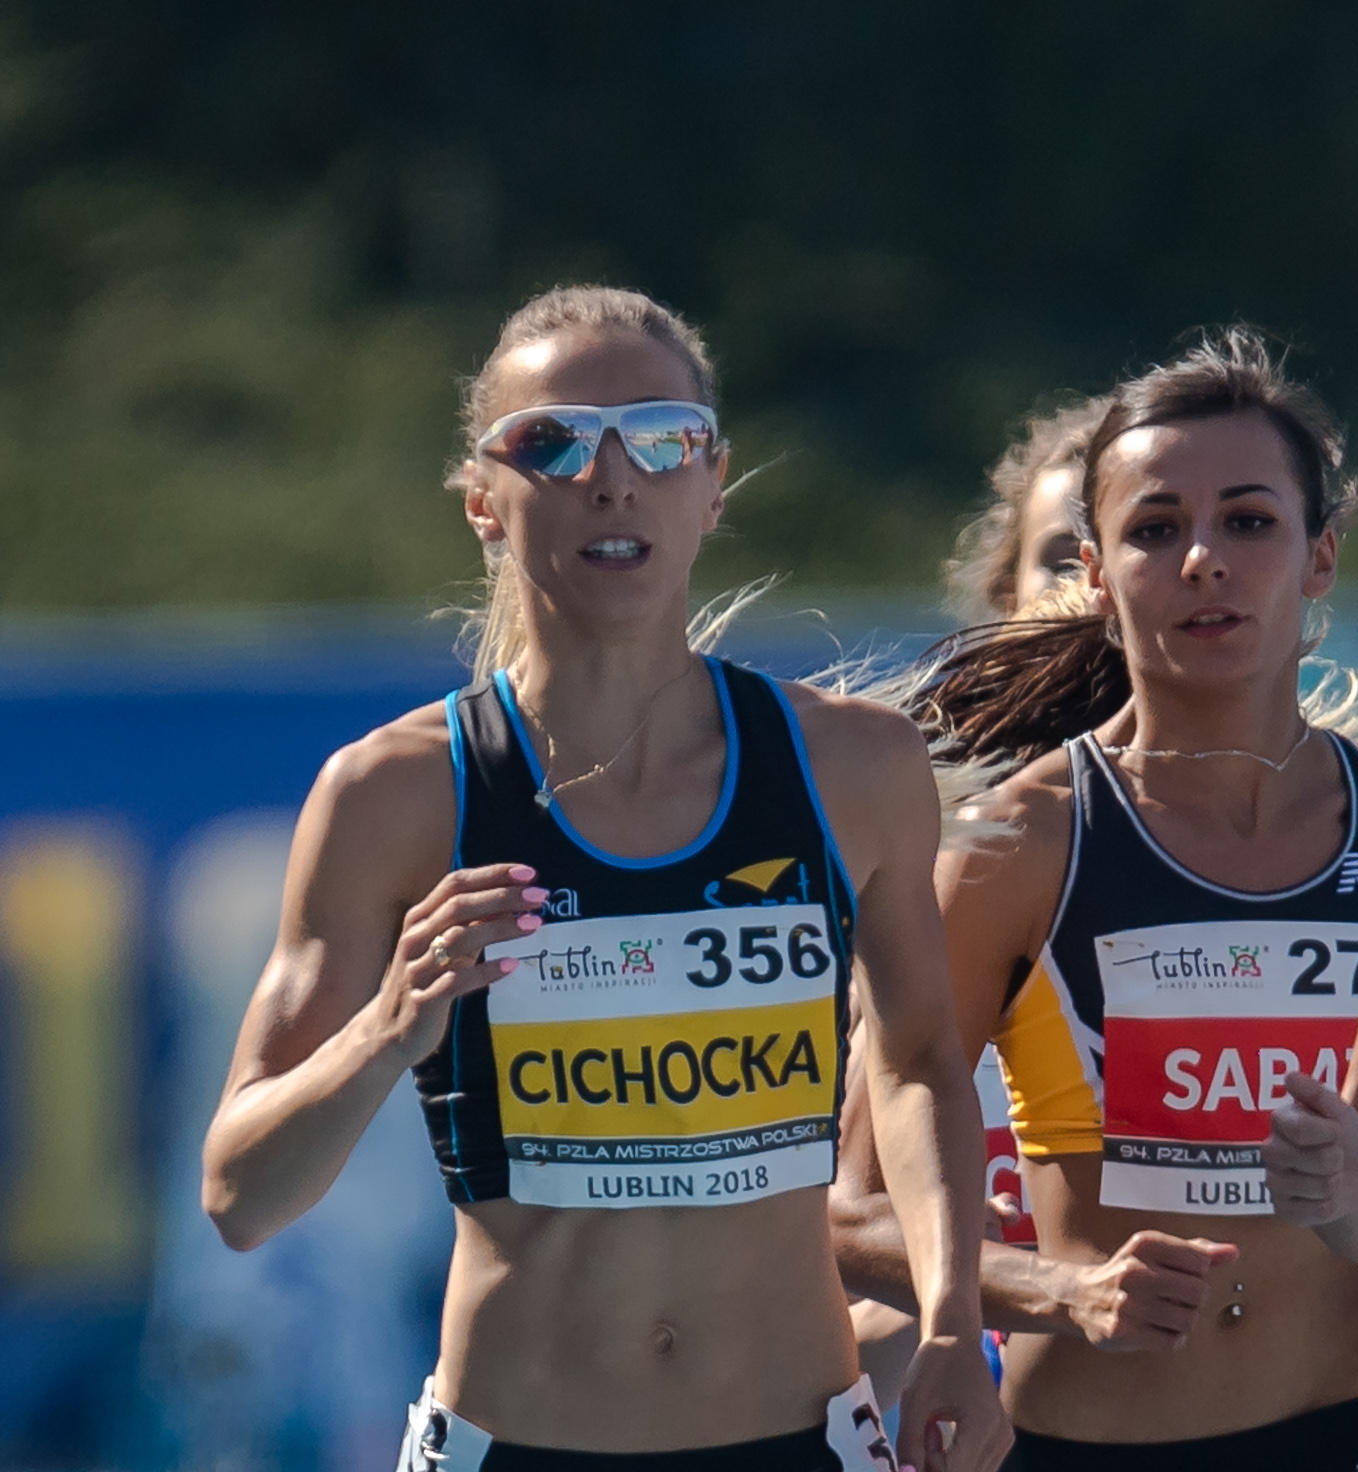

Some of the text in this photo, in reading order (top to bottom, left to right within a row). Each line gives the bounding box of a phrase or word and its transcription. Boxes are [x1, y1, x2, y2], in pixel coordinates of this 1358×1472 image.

[683, 922, 831, 988] 356
[509, 1029, 821, 1105] CICHOCKA
[1163, 1047, 1354, 1112] SABA
[521, 1123, 818, 1160] 94. PZLA MISTRZOSTWA POLSKI
[1119, 1144, 1151, 1161] 94.
[1156, 1146, 1212, 1165] PZLA
[587, 1165, 769, 1199] LUBLIN 2018
[1185, 1180, 1273, 1205] LUBLI
